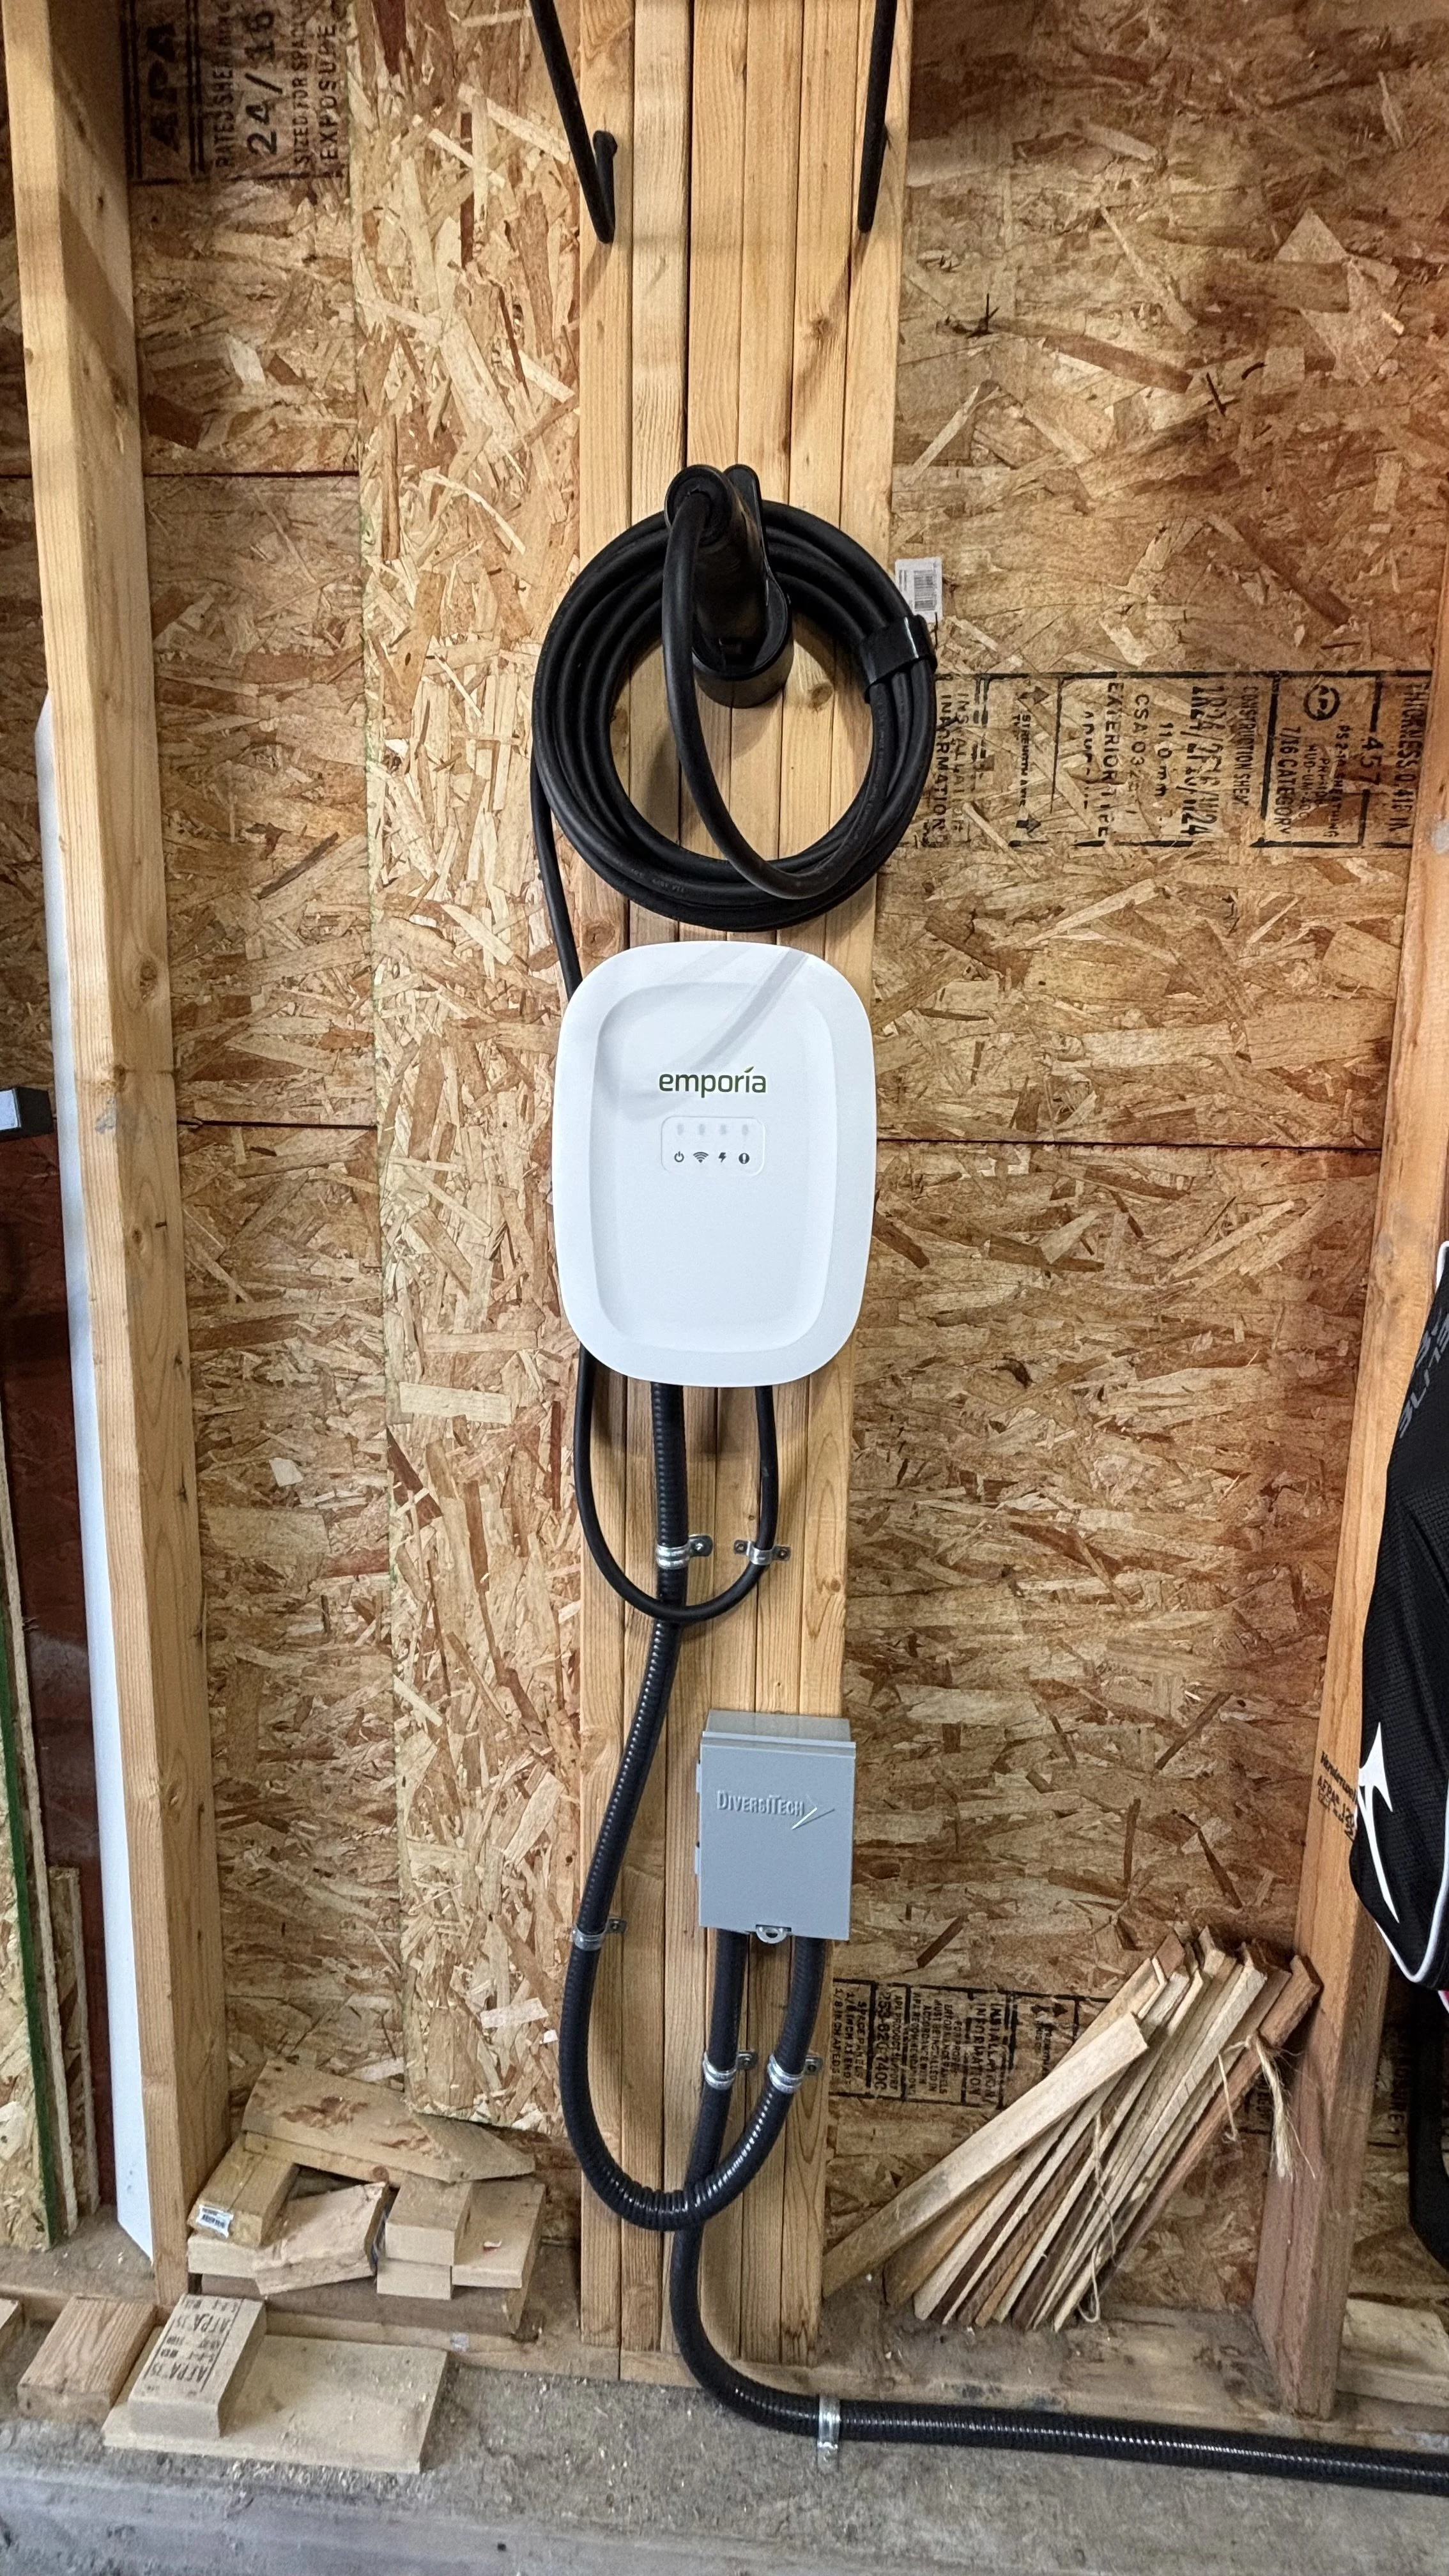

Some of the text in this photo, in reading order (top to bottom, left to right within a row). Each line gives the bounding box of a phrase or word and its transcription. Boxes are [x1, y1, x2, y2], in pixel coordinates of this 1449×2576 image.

[145, 22, 180, 154] APA
[240, 12, 283, 157] 24/16
[318, 24, 337, 160] EXPOSURE
[1101, 682, 1125, 783] EXTERIOR
[1131, 694, 1151, 734] CSA
[1233, 686, 1259, 770] CONSTRUCTION
[1273, 759, 1298, 834] CATEGORY
[941, 2002, 953, 2061] ERFORMANCE
